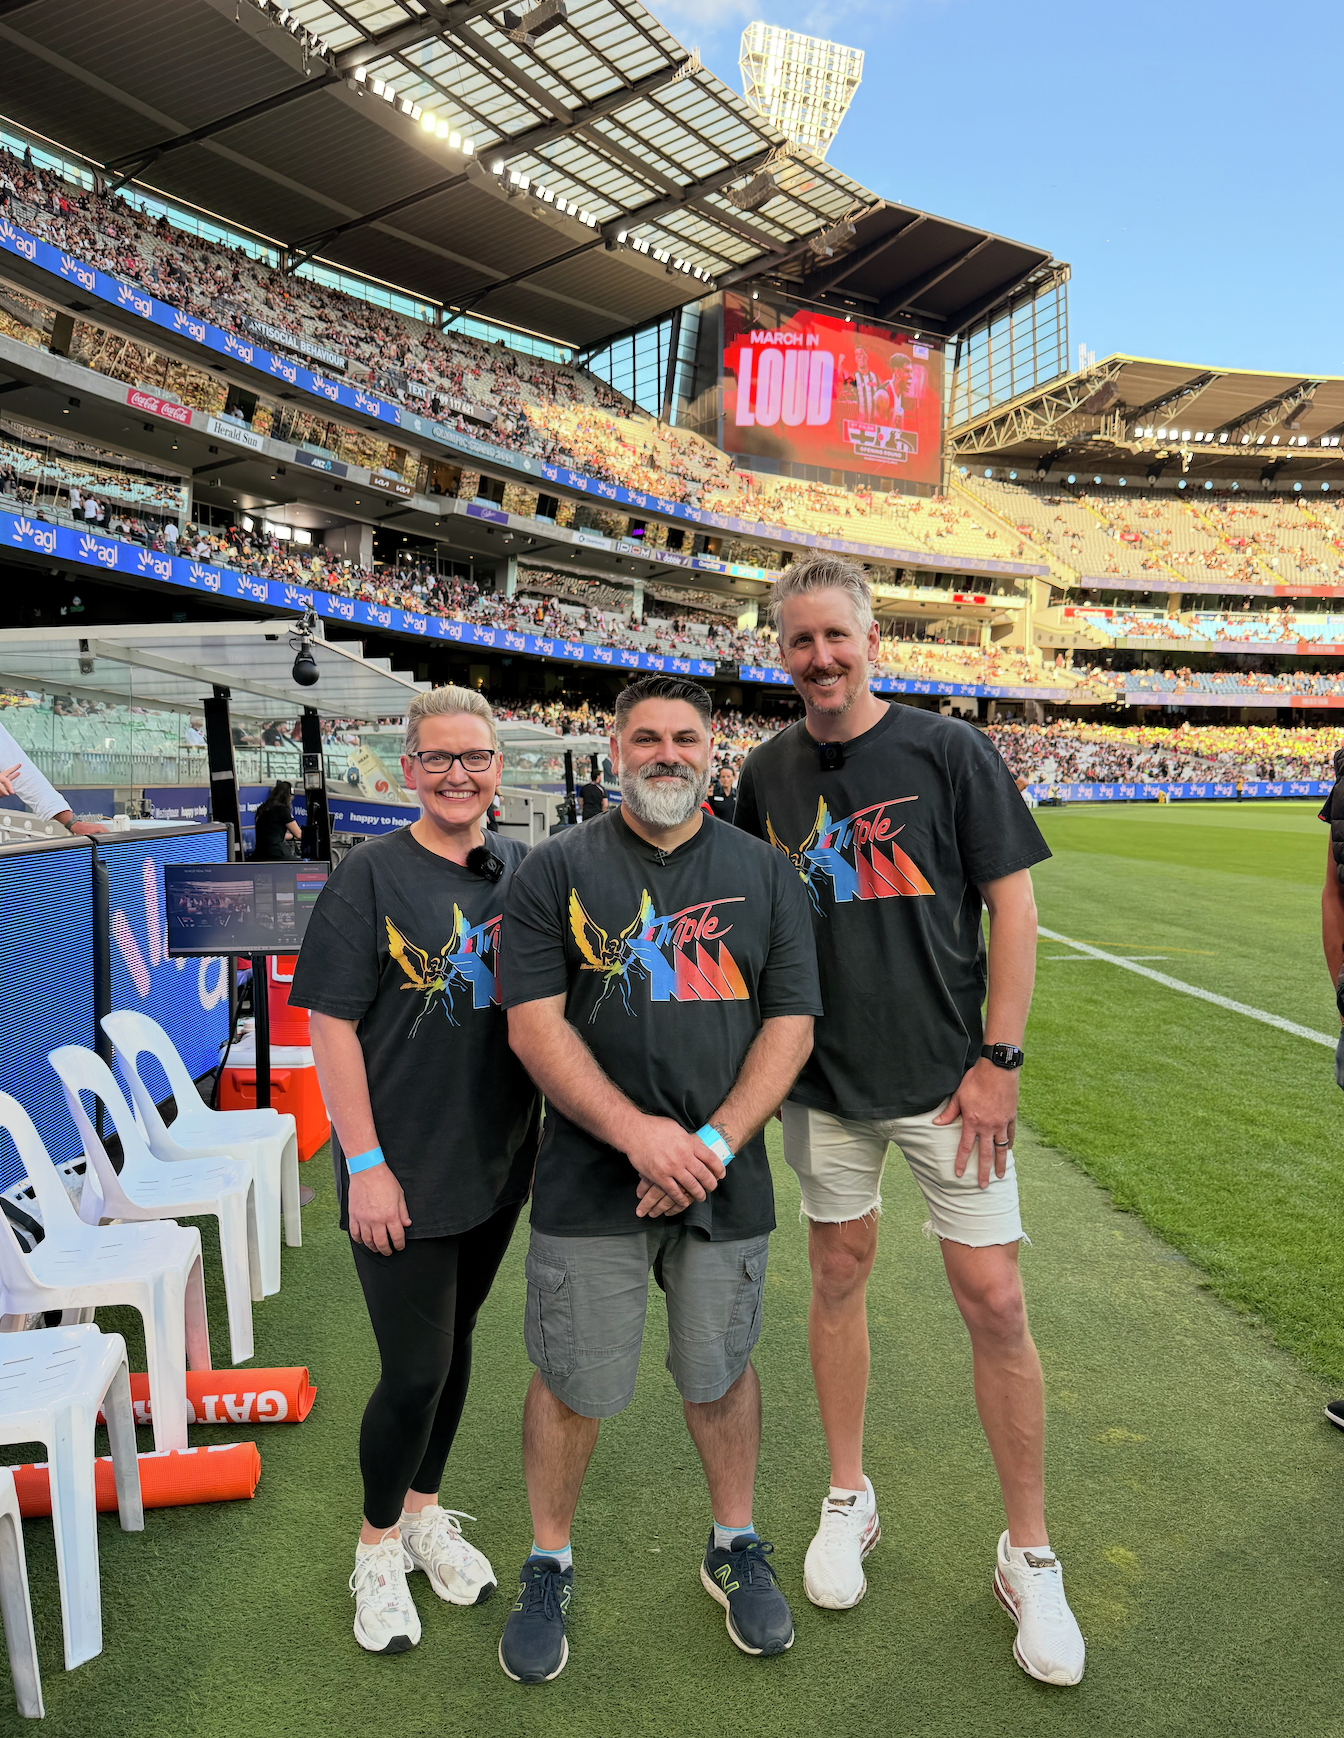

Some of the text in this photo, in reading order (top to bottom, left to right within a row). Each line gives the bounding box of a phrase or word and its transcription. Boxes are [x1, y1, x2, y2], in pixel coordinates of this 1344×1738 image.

[16, 236, 36, 260] agl
[77, 268, 95, 291] agl
[134, 297, 152, 318] agl
[189, 321, 205, 342] agl
[751, 331, 819, 346] MARCH IN
[249, 320, 345, 369] ANTISOCIAL BEHAVIOUR
[238, 345, 253, 363] agl
[282, 365, 296, 383] agl
[324, 383, 338, 401] agl
[407, 382, 426, 398] TEXT
[735, 347, 834, 426] LOUD
[367, 400, 380, 417] agl
[213, 422, 258, 447] Herald Sun
[311, 458, 325, 469] ANZ
[547, 468, 557, 481] agl
[577, 478, 587, 490] agl
[606, 488, 616, 500] agl
[636, 496, 646, 507] agl
[665, 504, 674, 515] agl
[34, 529, 56, 553] agl
[98, 545, 118, 568] agl
[617, 542, 651, 557] IDIOM
[154, 559, 172, 580] agl
[737, 568, 758, 578] OPTUS
[204, 571, 221, 592] agl
[252, 582, 268, 602] agl
[340, 602, 354, 620] agl
[378, 610, 391, 627] agl
[413, 618, 426, 634] agl
[450, 624, 462, 640] agl
[483, 631, 495, 646] agl
[514, 636, 525, 651] agl
[543, 641, 553, 656] agl
[573, 646, 584, 660] agl
[602, 650, 612, 664] agl
[629, 654, 639, 667] agl
[655, 658, 664, 671] agl
[680, 661, 690, 673] agl
[754, 670, 765, 681] agl
[778, 673, 789, 684] agl
[1085, 786, 1093, 799] agl
[1106, 786, 1114, 799] agl
[1127, 785, 1135, 798] agl
[1151, 785, 1160, 798] agl
[1174, 785, 1183, 798] agl
[1198, 785, 1206, 797] agl
[1223, 784, 1233, 797] agl
[1249, 784, 1258, 796] agl
[1274, 783, 1283, 796] agl
[1300, 783, 1310, 795] agl
[156, 807, 179, 820] Westinghouse
[181, 806, 194, 818] happy
[198, 805, 207, 817] help
[350, 812, 379, 825] happy
[381, 817, 391, 825] to
[825, 796, 919, 853] Triple
[650, 897, 745, 950] Triple
